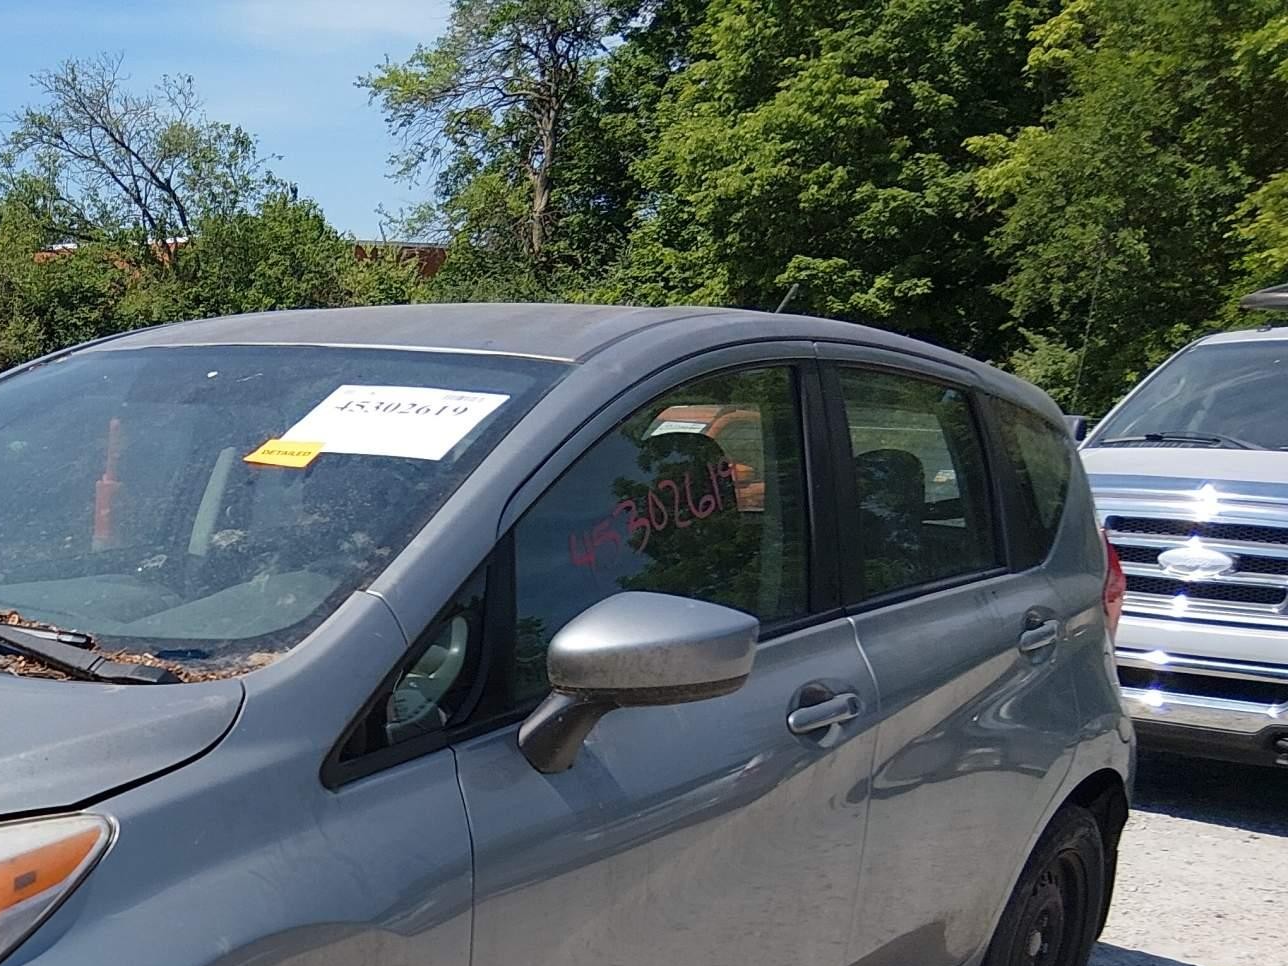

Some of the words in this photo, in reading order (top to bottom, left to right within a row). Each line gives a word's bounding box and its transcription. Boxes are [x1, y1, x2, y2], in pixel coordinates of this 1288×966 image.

[335, 400, 470, 417] 45302619
[261, 449, 312, 458] DETAILED
[569, 455, 737, 573] 45302619
